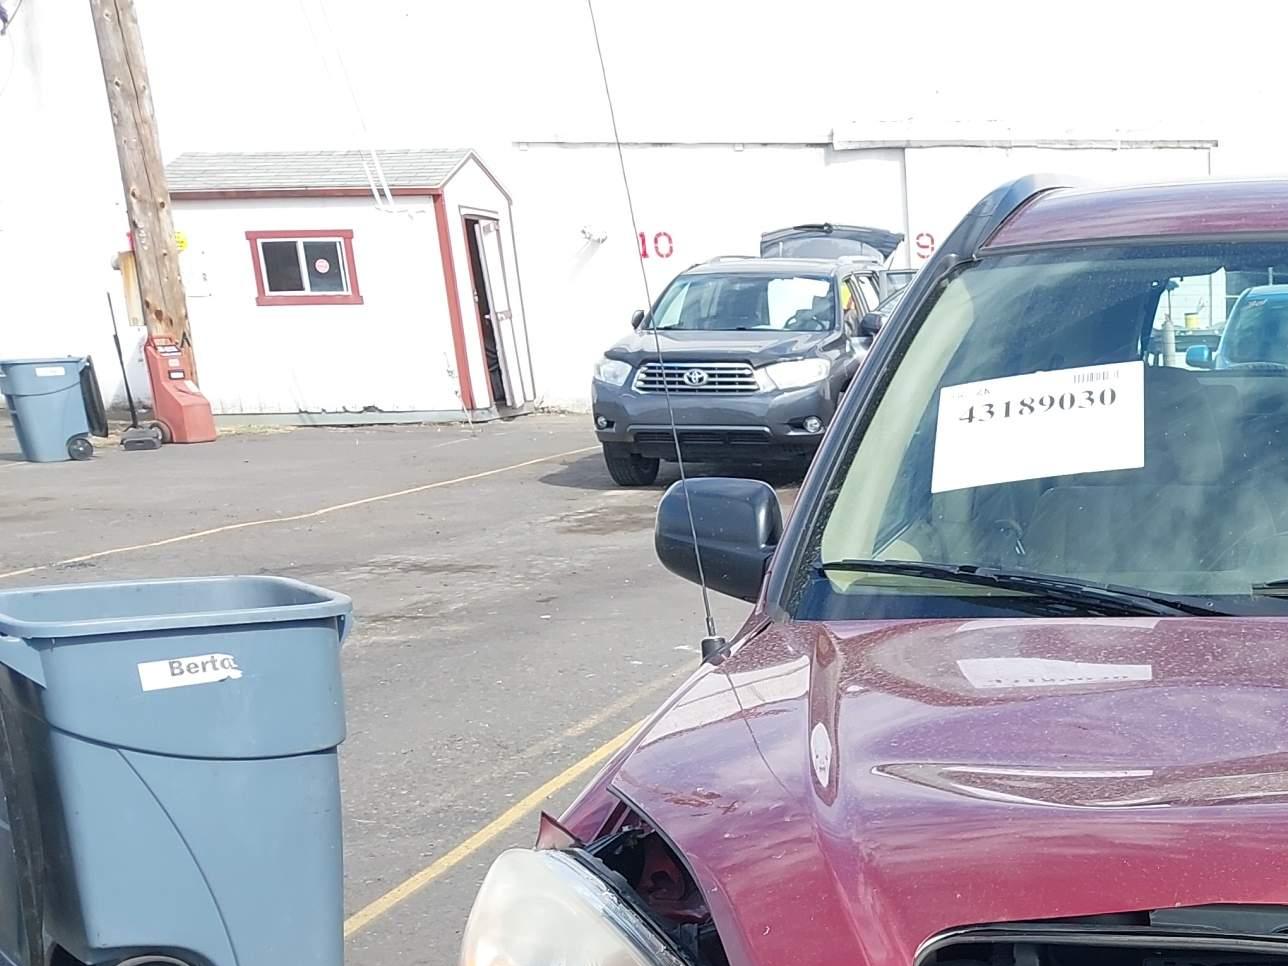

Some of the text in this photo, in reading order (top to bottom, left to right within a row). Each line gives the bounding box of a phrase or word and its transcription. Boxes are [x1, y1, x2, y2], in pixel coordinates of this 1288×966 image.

[639, 232, 673, 258] 10
[916, 233, 935, 259] 9
[958, 387, 1117, 423] 43189030
